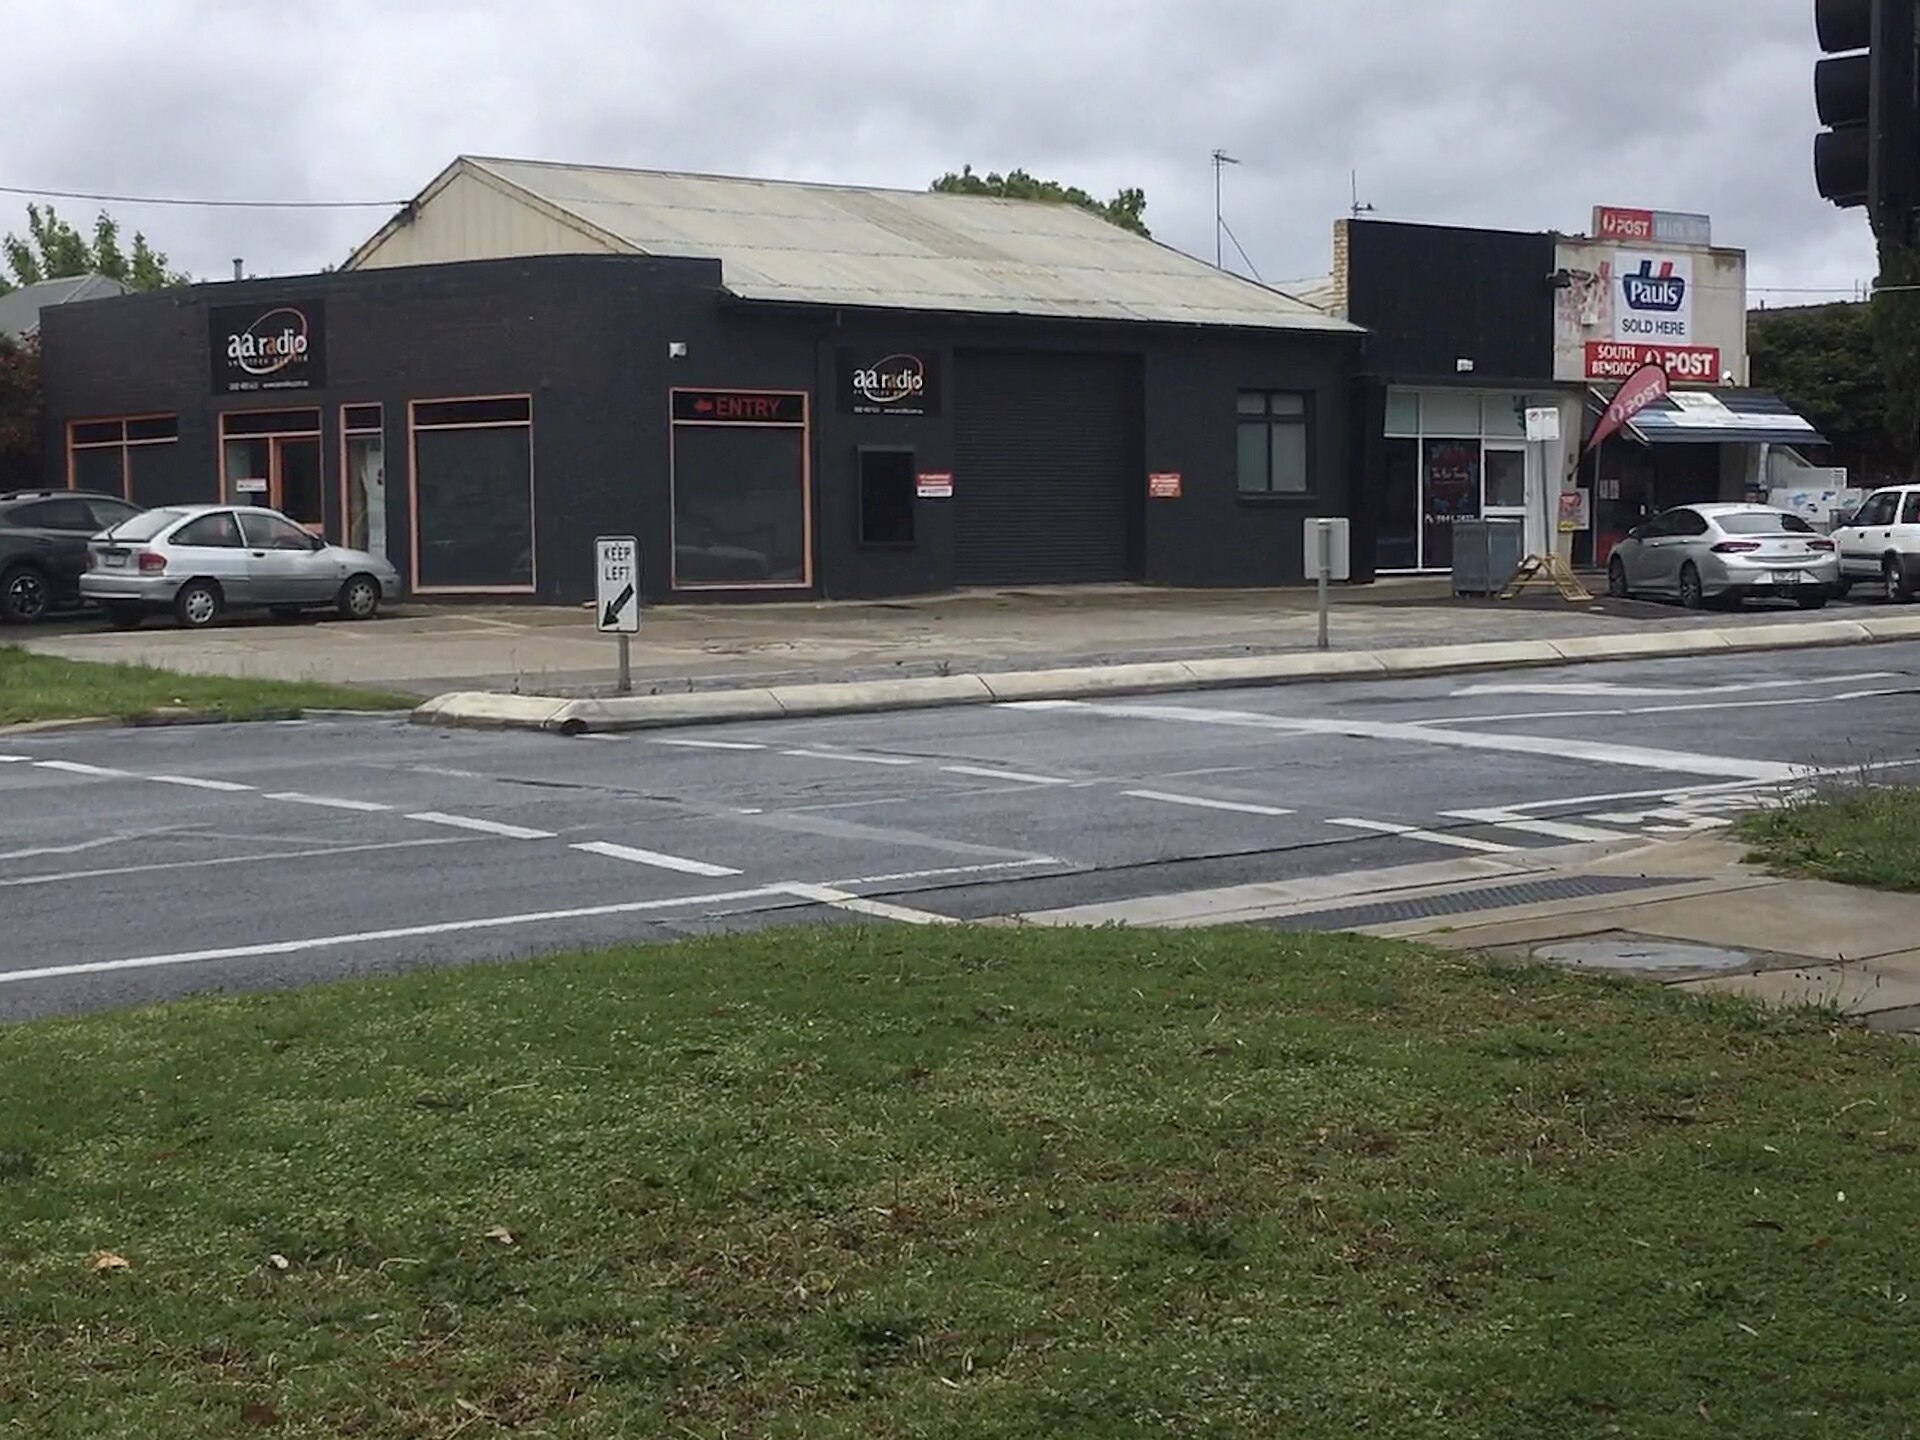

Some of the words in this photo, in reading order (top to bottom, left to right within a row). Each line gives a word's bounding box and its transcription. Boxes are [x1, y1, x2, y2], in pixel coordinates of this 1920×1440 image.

[1617, 219, 1649, 236] POST
[1631, 280, 1679, 305] Pauls
[1622, 318, 1653, 334] SOLD
[1656, 321, 1685, 336] HERE
[227, 333, 256, 357] aa
[259, 328, 308, 355] radio
[1597, 345, 1636, 360] SOUTH
[1664, 351, 1714, 375] POST
[853, 369, 879, 389] aa
[716, 397, 780, 417] ENTRY
[1624, 380, 1662, 415] POST
[604, 546, 631, 561] KEEP
[605, 566, 631, 581] LEFT
